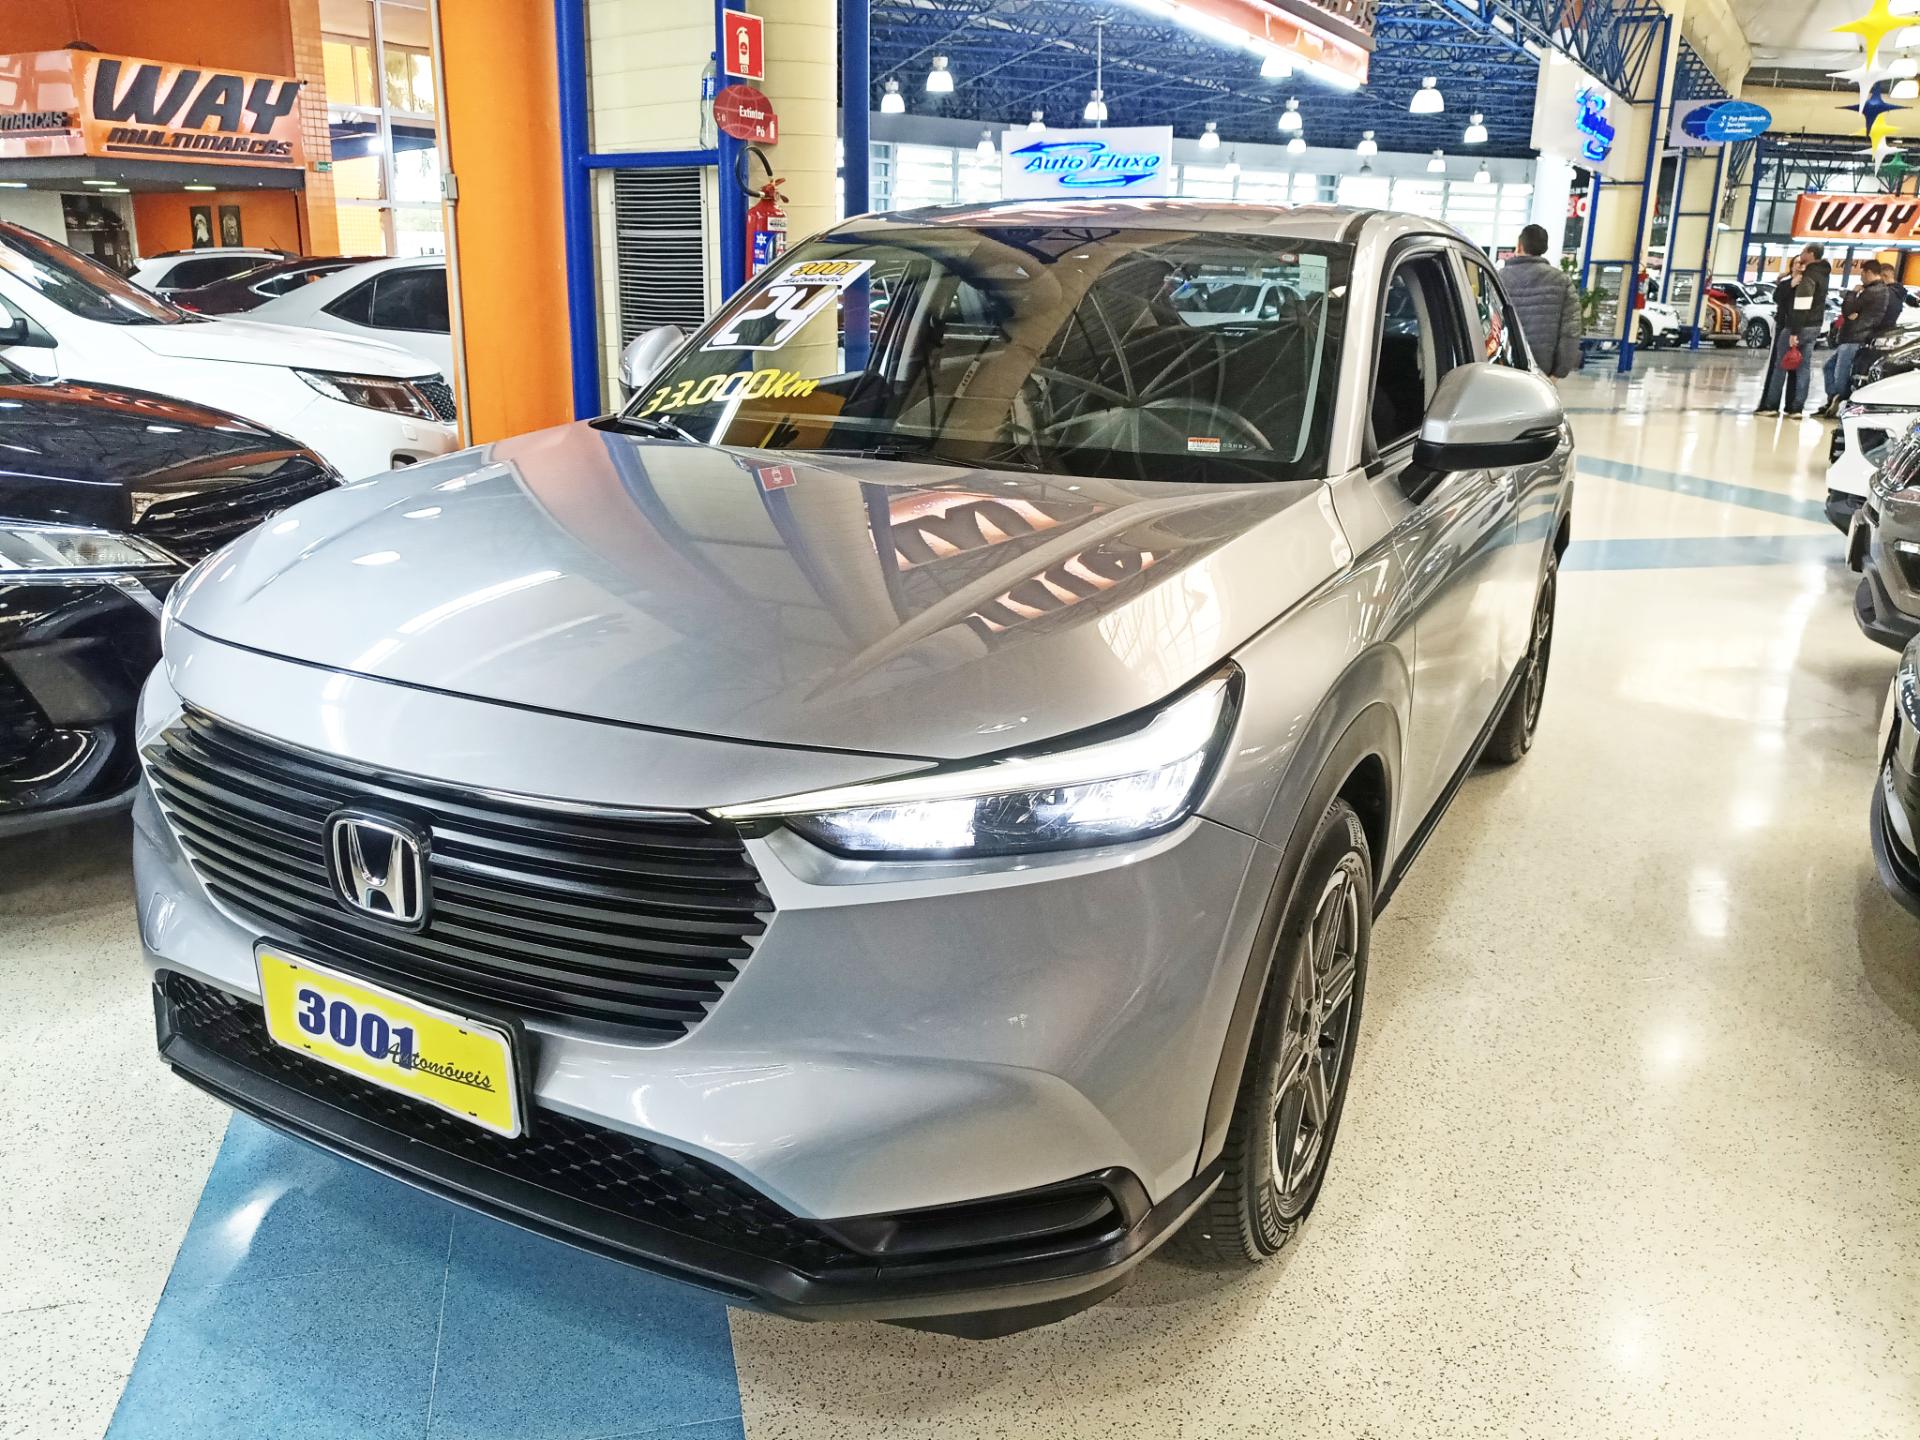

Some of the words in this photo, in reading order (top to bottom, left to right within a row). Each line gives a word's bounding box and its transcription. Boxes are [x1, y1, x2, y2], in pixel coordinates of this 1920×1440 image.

[93, 58, 300, 134] WAY
[739, 105, 765, 120] Extintor
[106, 127, 293, 155] MULTIMARCAS
[756, 125, 766, 138] Pó
[1024, 154, 1084, 171] Auto
[1089, 153, 1162, 169] Fluxo
[1810, 202, 1917, 234] WAY
[790, 261, 861, 276] 3001
[712, 286, 837, 345] 24
[298, 989, 414, 1071] 3001
[387, 1041, 493, 1089] Automóveis
